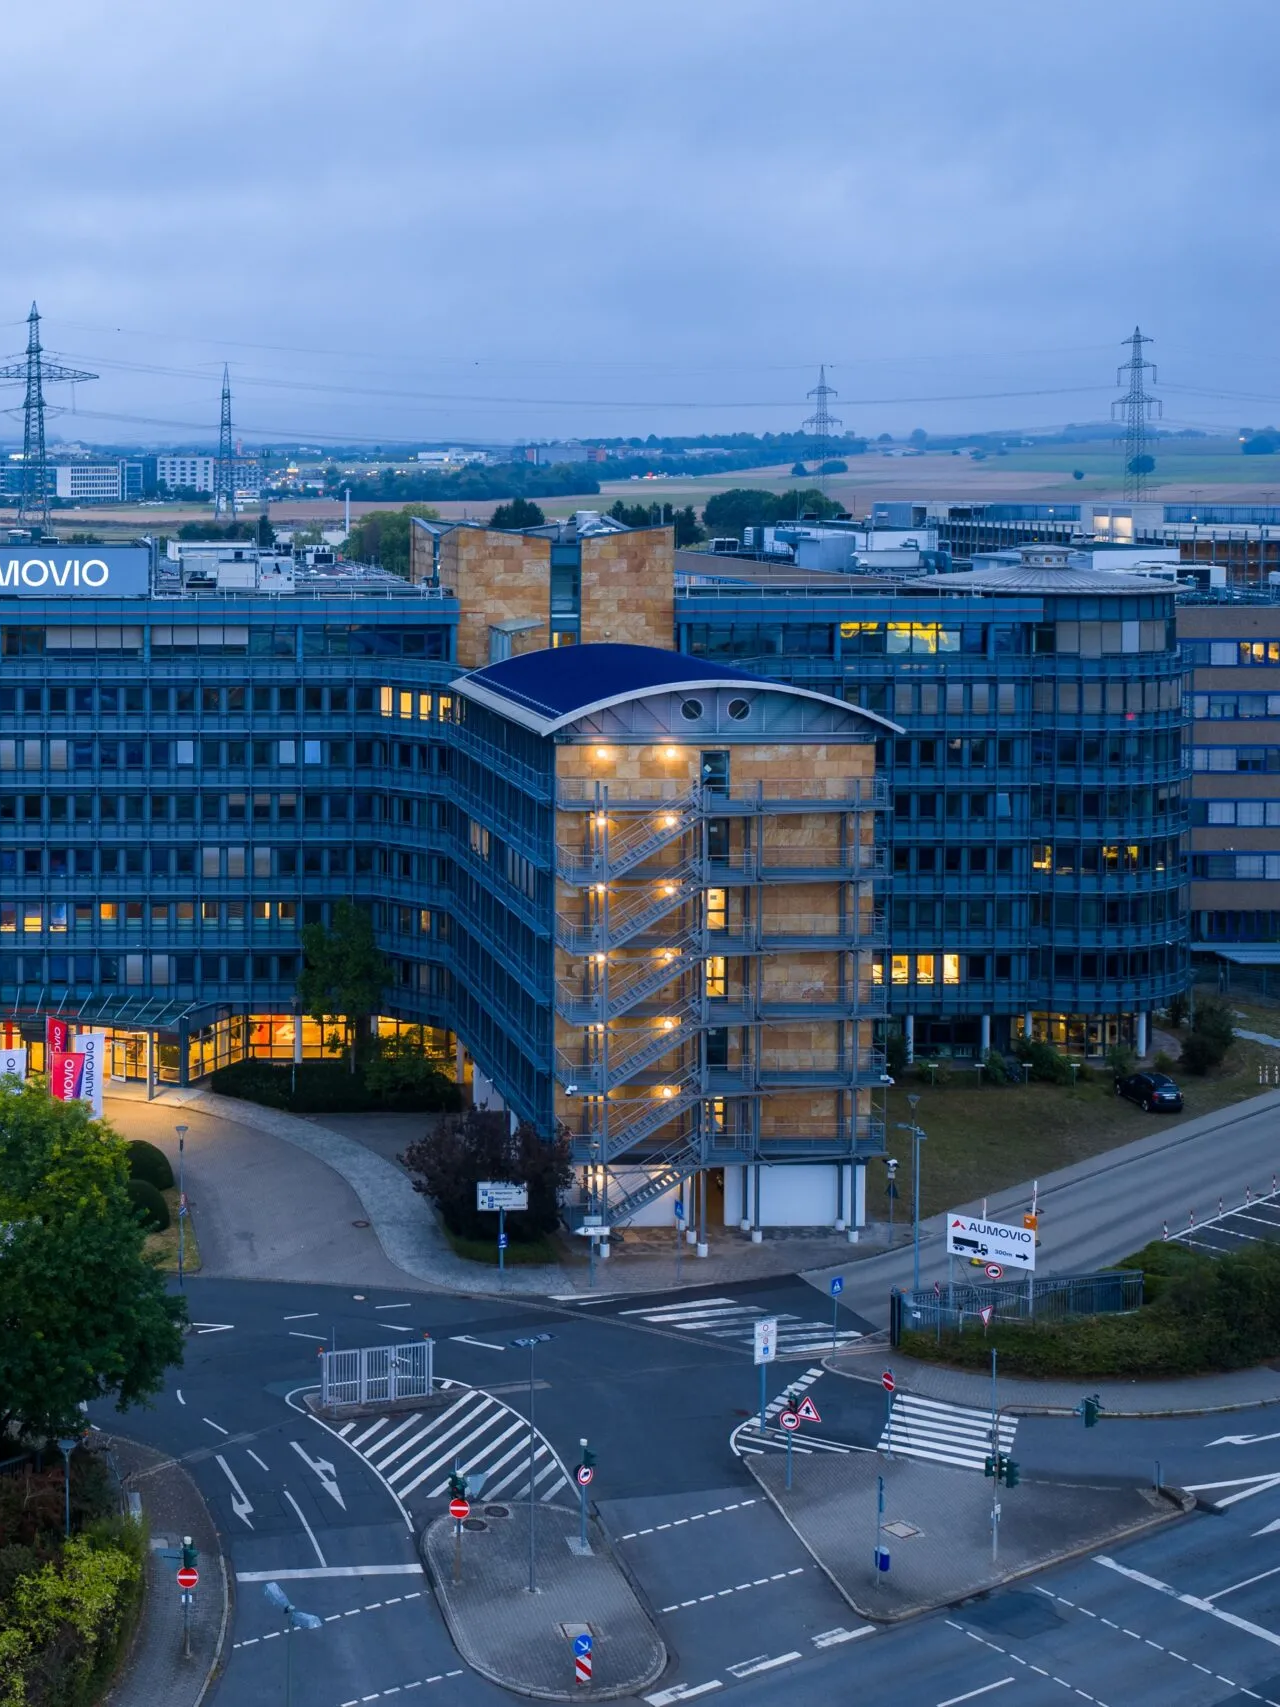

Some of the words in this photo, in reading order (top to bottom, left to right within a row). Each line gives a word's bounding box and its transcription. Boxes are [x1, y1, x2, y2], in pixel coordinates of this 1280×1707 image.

[85, 1041, 95, 1097] AUMOVIO
[968, 1222, 1031, 1243] AUMOVIO
[994, 1248, 1012, 1257] 300m
